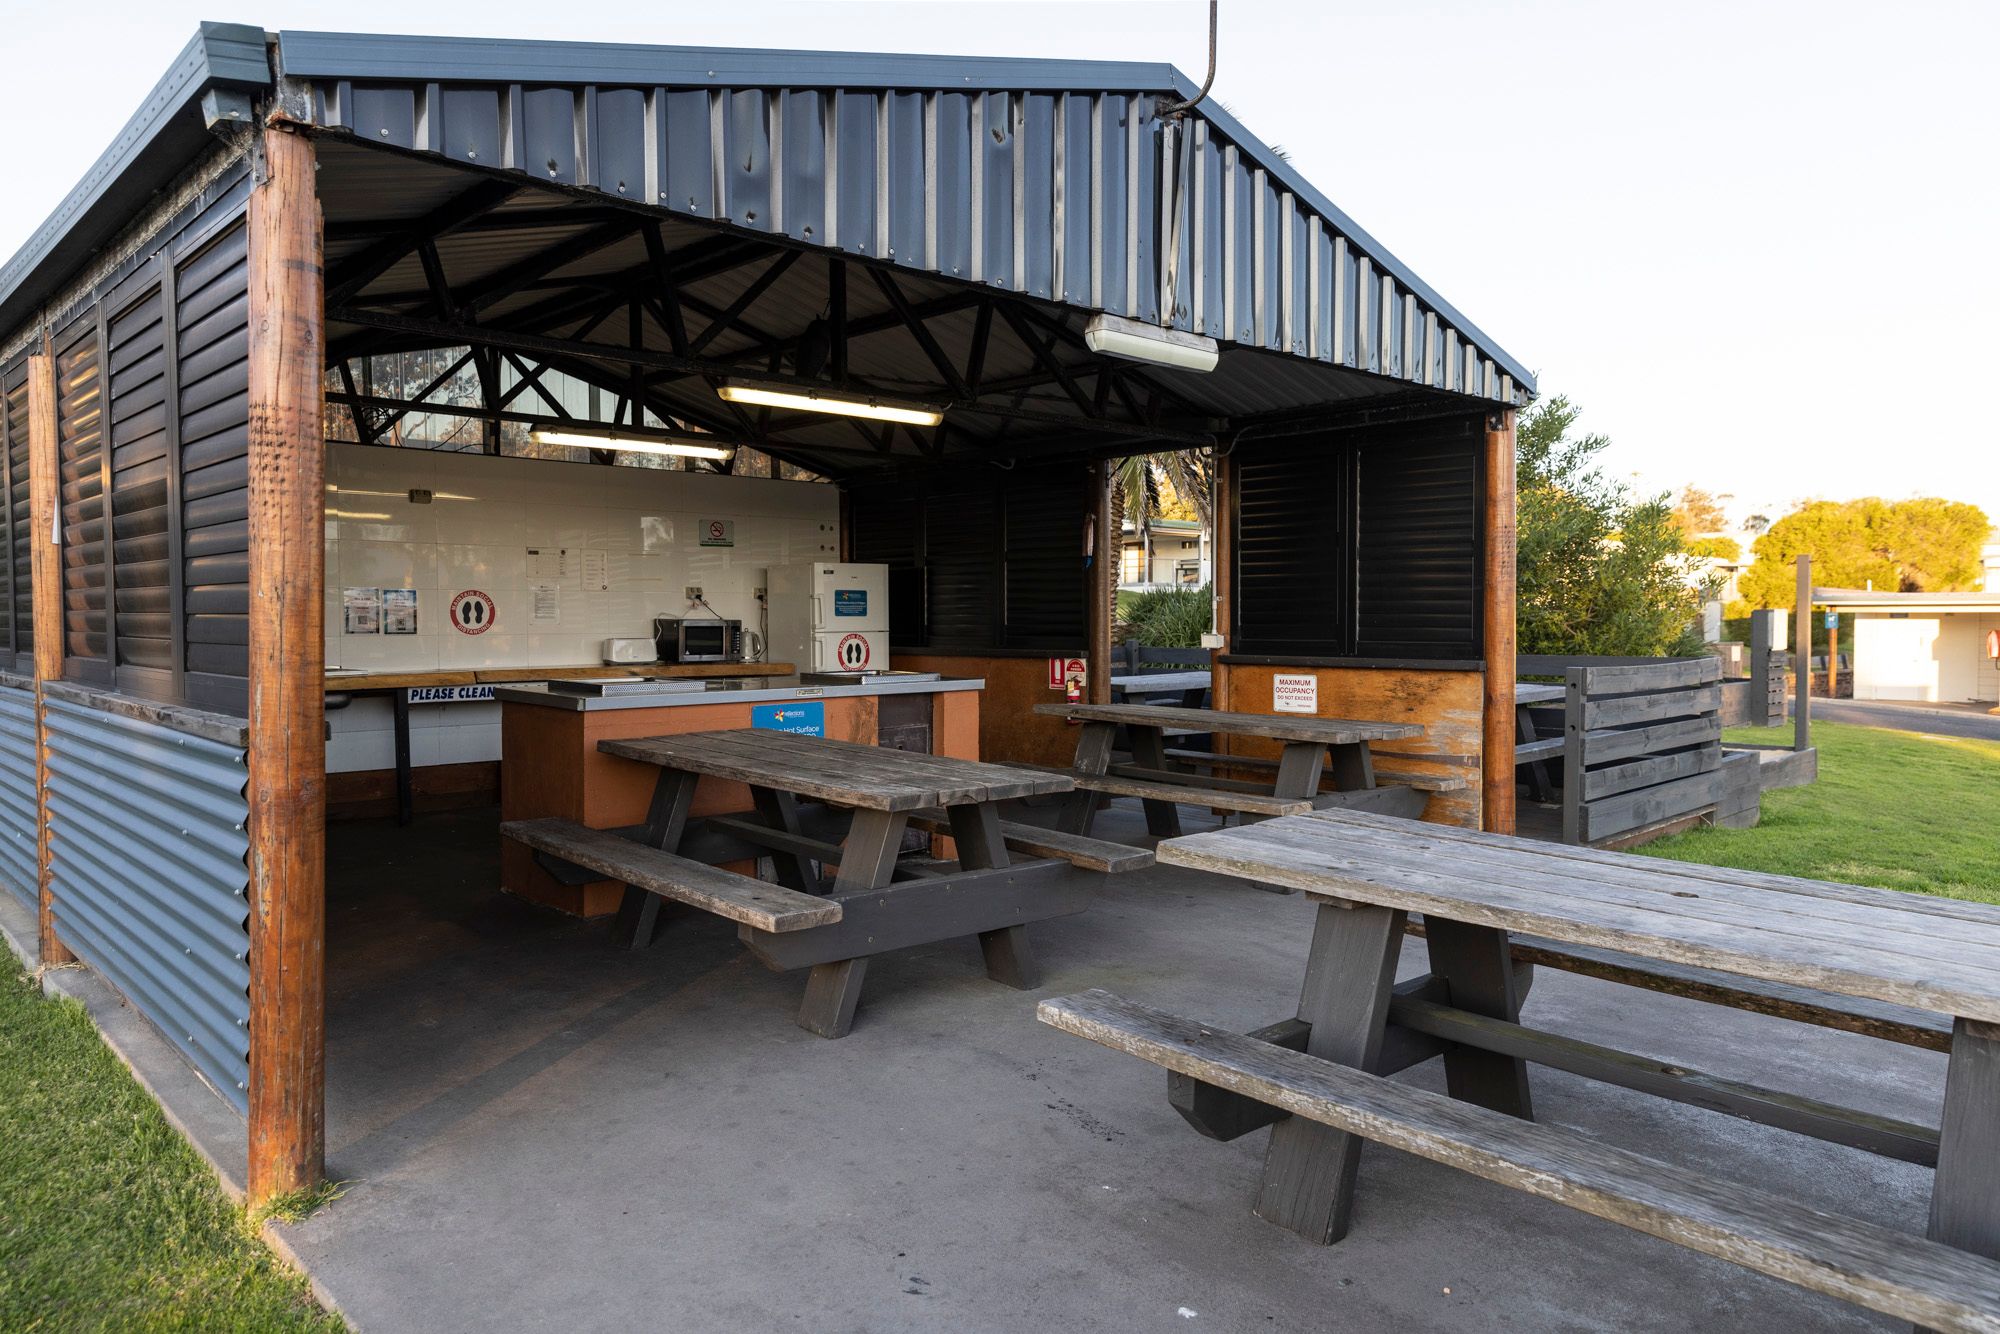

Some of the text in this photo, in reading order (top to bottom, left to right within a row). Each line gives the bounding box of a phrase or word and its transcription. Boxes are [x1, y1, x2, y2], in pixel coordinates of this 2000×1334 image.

[451, 591, 493, 610] MAINTAIN SOCIAL
[457, 623, 491, 635] DISTANCING
[411, 687, 495, 700] PLEASE CLEAN
[796, 725, 820, 734] Surface
